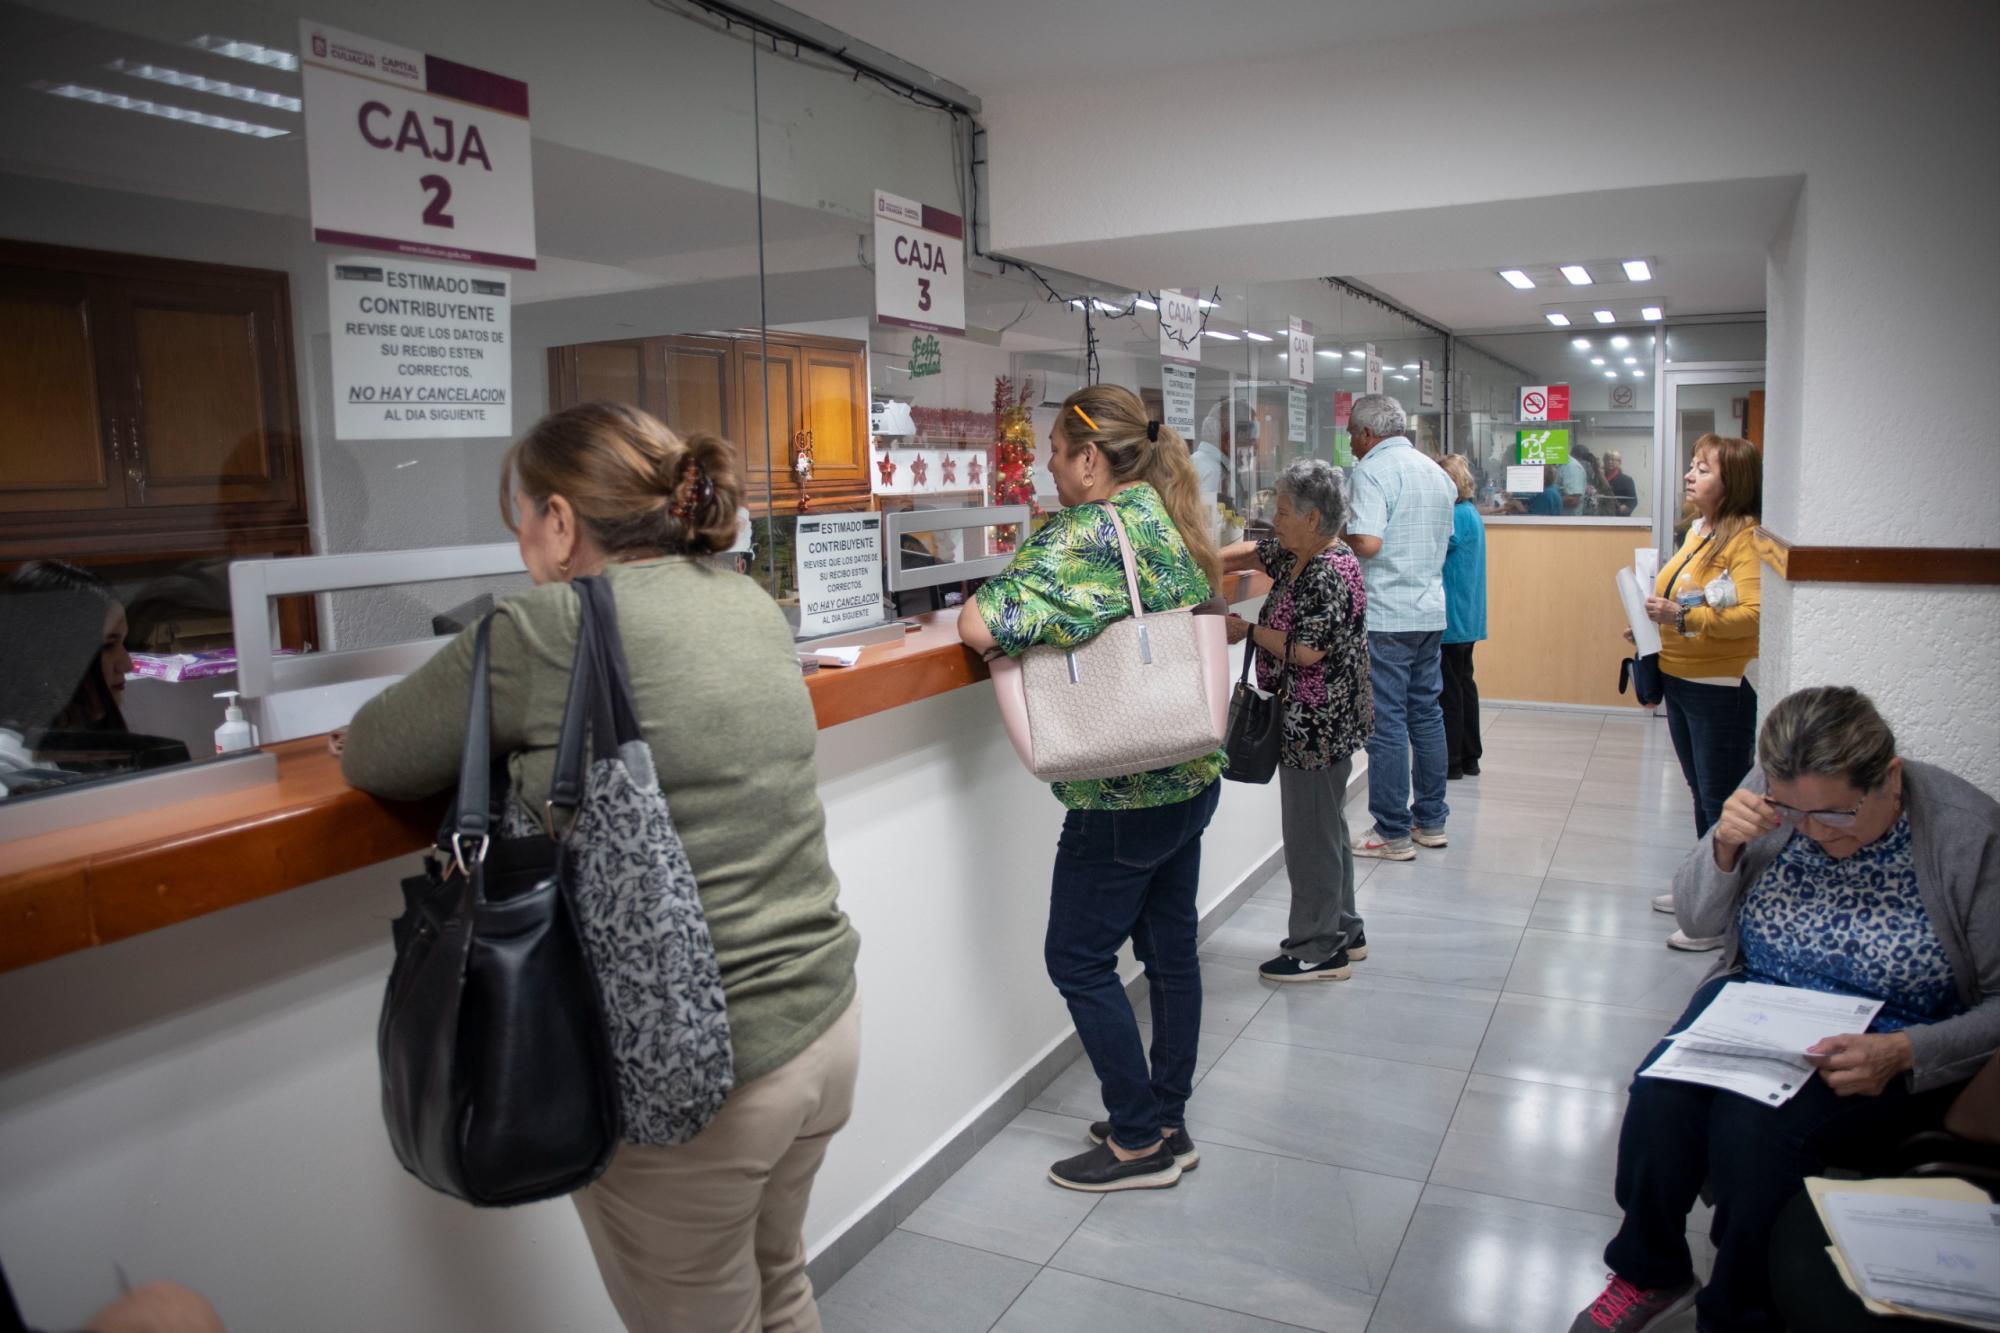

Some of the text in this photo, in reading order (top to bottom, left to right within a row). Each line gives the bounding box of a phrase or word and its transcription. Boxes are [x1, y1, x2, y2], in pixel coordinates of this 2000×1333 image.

[381, 56, 419, 74] CAPITAL
[358, 101, 493, 171] CAJA
[420, 174, 454, 229] 2
[894, 235, 947, 275] CAJA
[387, 271, 469, 294] ESTIMADO
[918, 278, 931, 311] 3
[359, 297, 495, 322] CONTRIBUYENTE
[1168, 300, 1193, 325] CAJA
[346, 322, 504, 343] REVISE QUE LOS DATOS DE
[381, 344, 484, 360] SU RECIBO ESTEN
[349, 386, 506, 402] NO HAY CANCELACION
[384, 409, 486, 421] AL DIA SIGUIENTE
[821, 521, 861, 534] ESTIMADO
[808, 537, 874, 554] CONTRIBUYENTE
[803, 553, 878, 569] REVISE QUE LOS DATOS DE
[819, 567, 868, 581] SU RECIBO ESTEN
[807, 593, 880, 613] NO HAY CANCELACION
[822, 608, 870, 624] AL DIA SIGUIENTE
